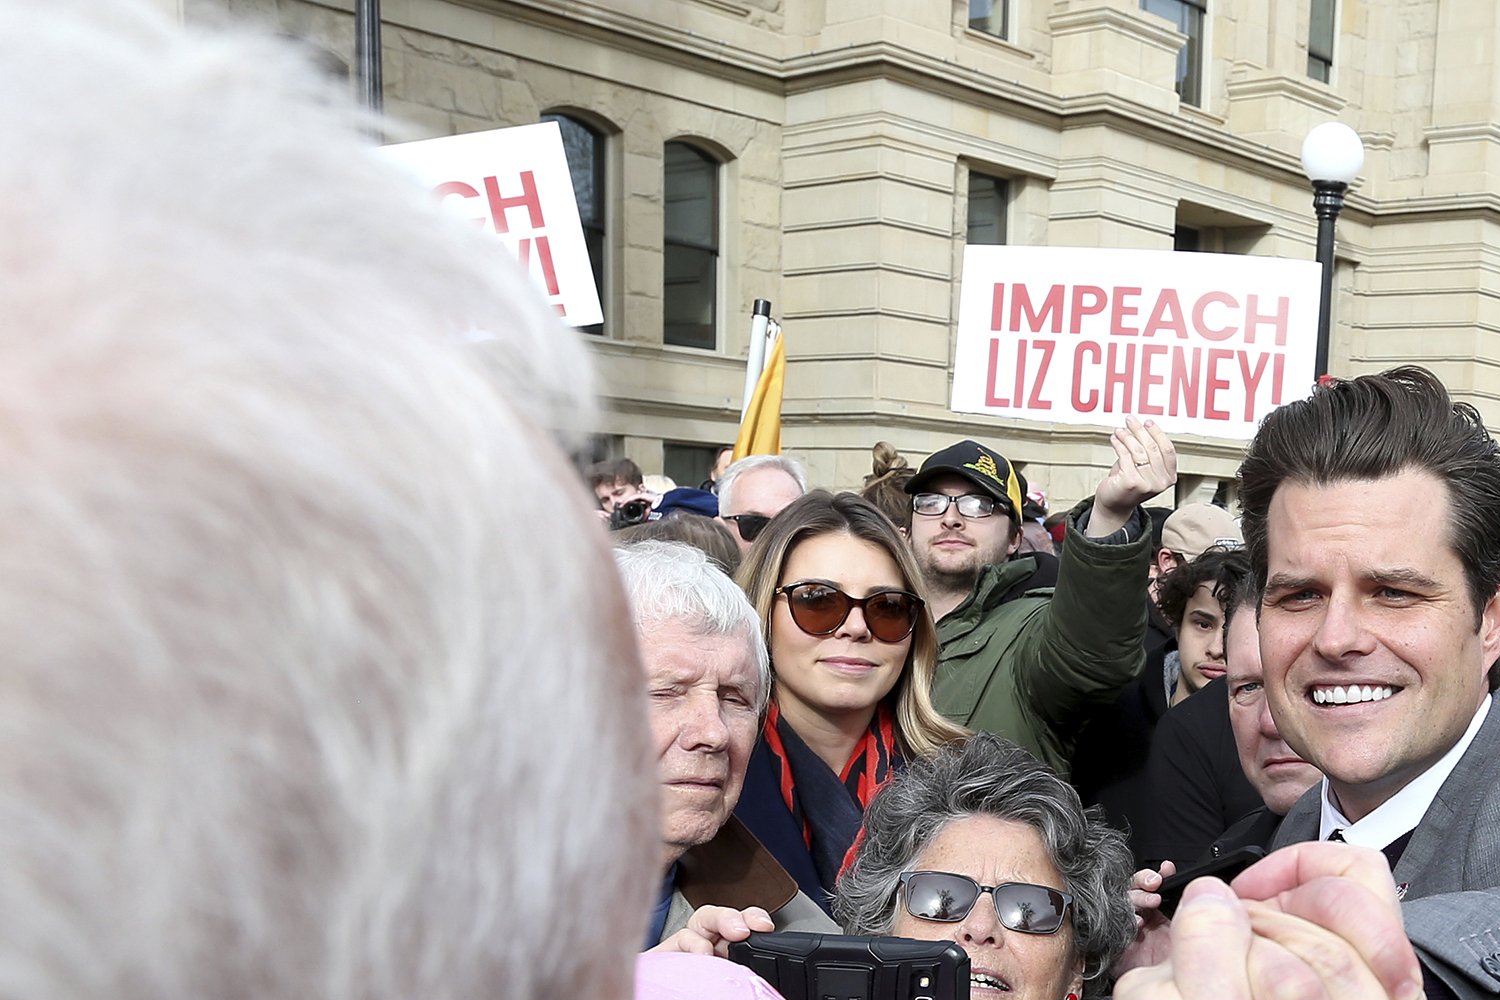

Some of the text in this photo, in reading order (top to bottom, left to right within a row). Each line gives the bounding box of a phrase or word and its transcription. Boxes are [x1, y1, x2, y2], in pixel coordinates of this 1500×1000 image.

[990, 282, 1290, 346] IMPEACH
[984, 337, 1286, 422] LIZ CHENEY!
